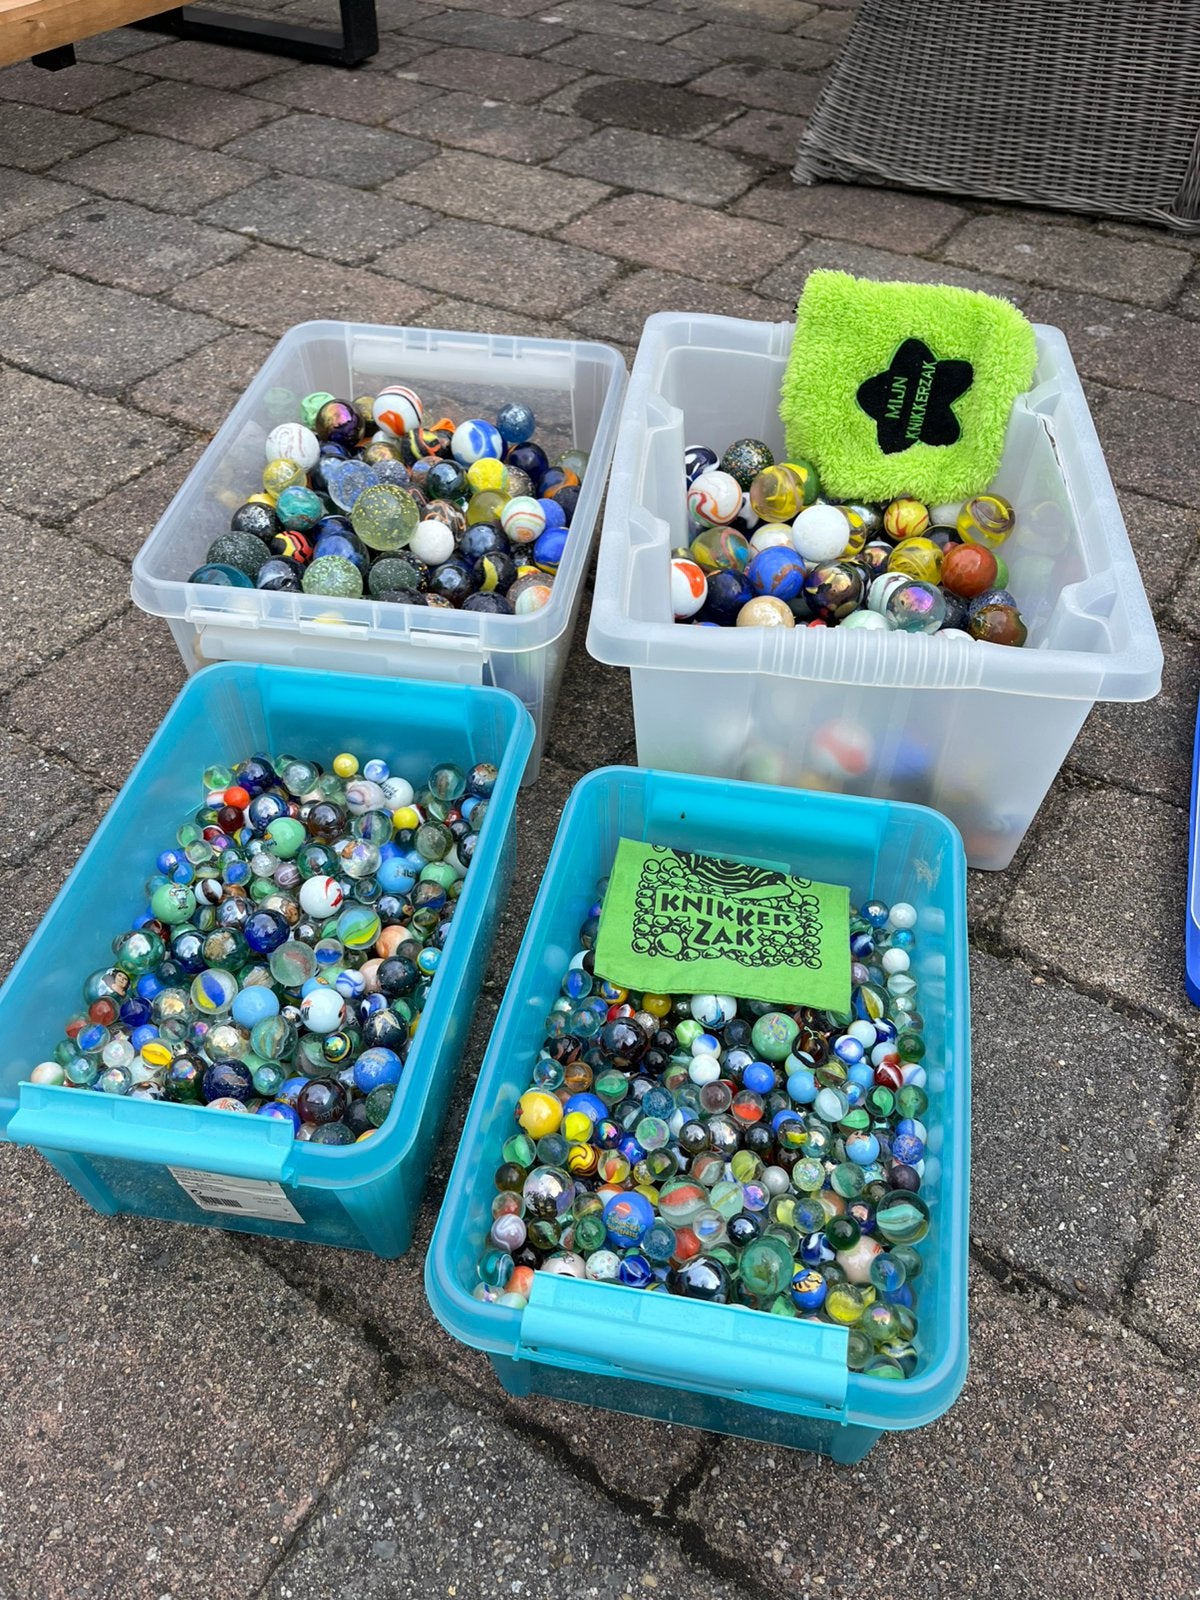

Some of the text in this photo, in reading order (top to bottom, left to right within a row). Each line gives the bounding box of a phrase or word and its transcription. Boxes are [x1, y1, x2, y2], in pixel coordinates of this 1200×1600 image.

[885, 376, 908, 419] MIJN
[905, 360, 938, 439] KNIKKERZAK
[660, 892, 793, 927] KNIKKER
[692, 918, 755, 947] ZAK
